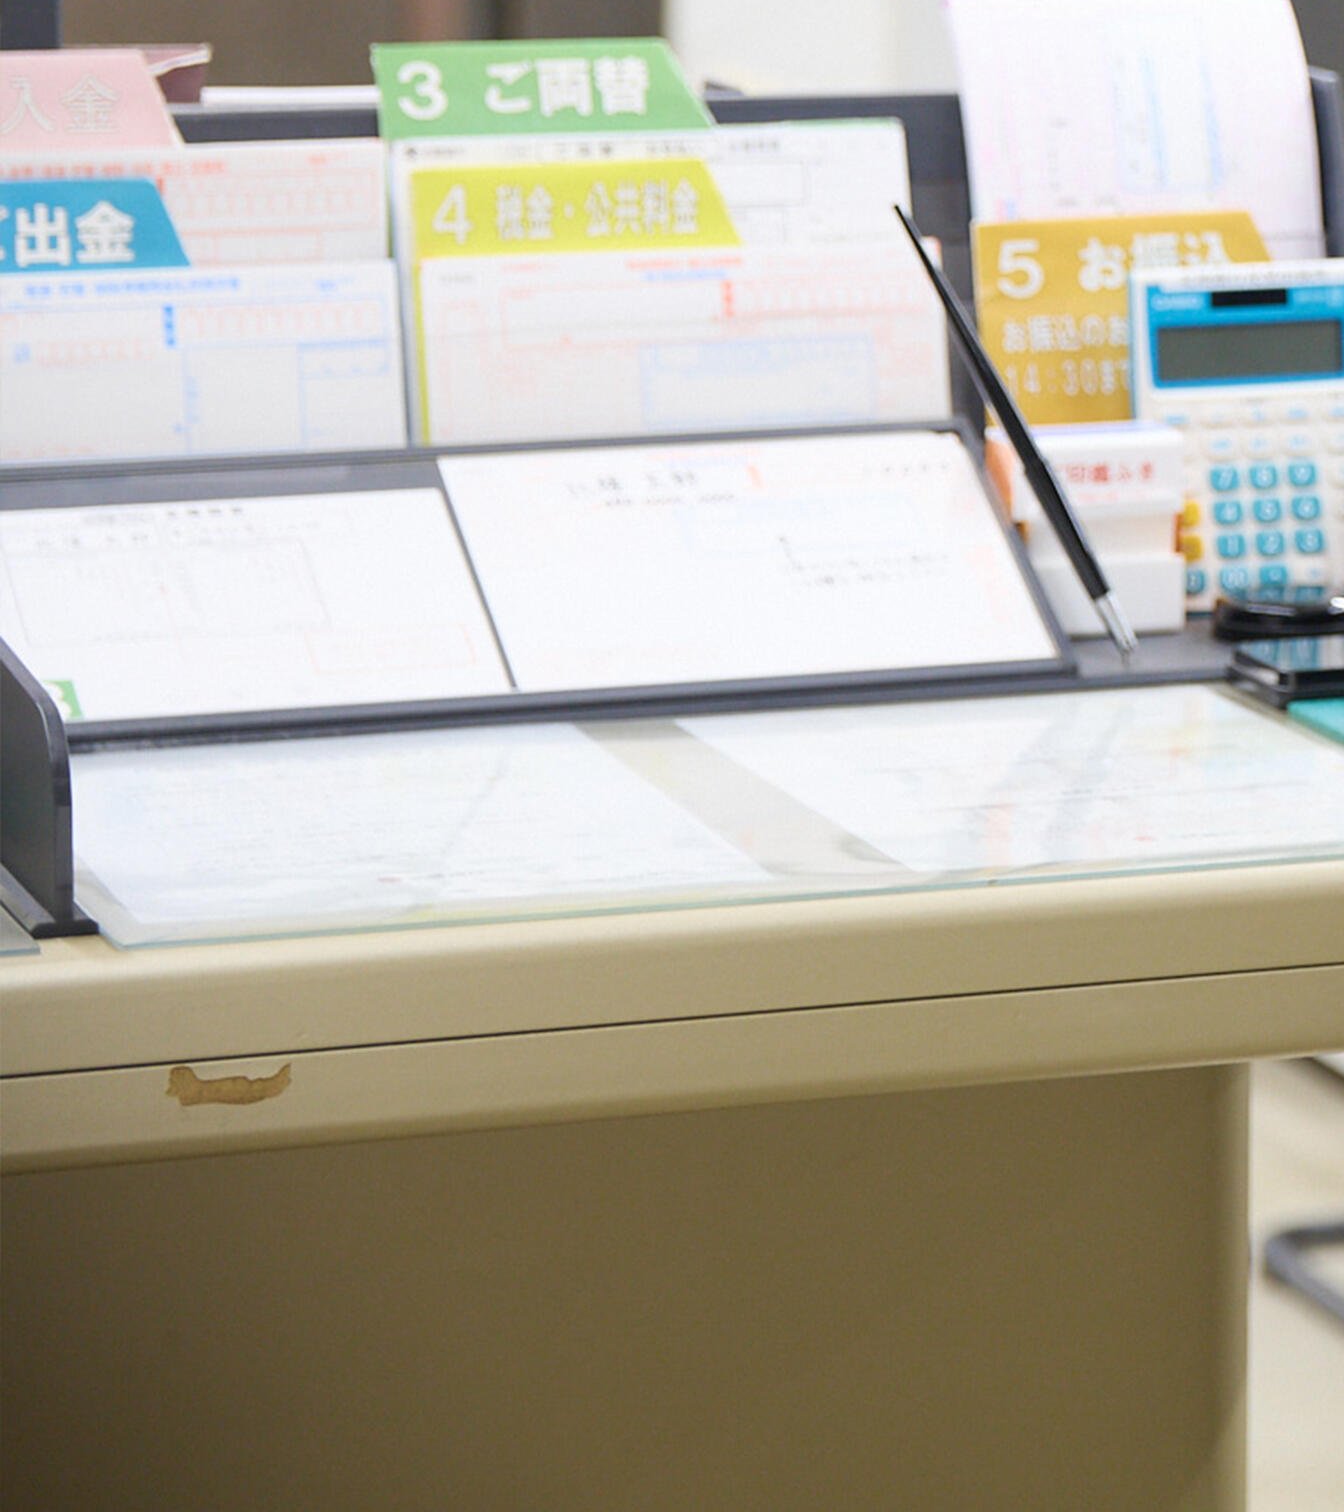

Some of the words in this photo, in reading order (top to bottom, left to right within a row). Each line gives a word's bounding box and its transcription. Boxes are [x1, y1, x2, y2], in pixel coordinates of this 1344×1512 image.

[1, 74, 120, 134] 入金
[397, 61, 448, 121] 3
[484, 55, 649, 117] ご両替
[431, 185, 473, 245] 4
[495, 177, 700, 241] 税金・公共料金
[996, 238, 1044, 299] 5
